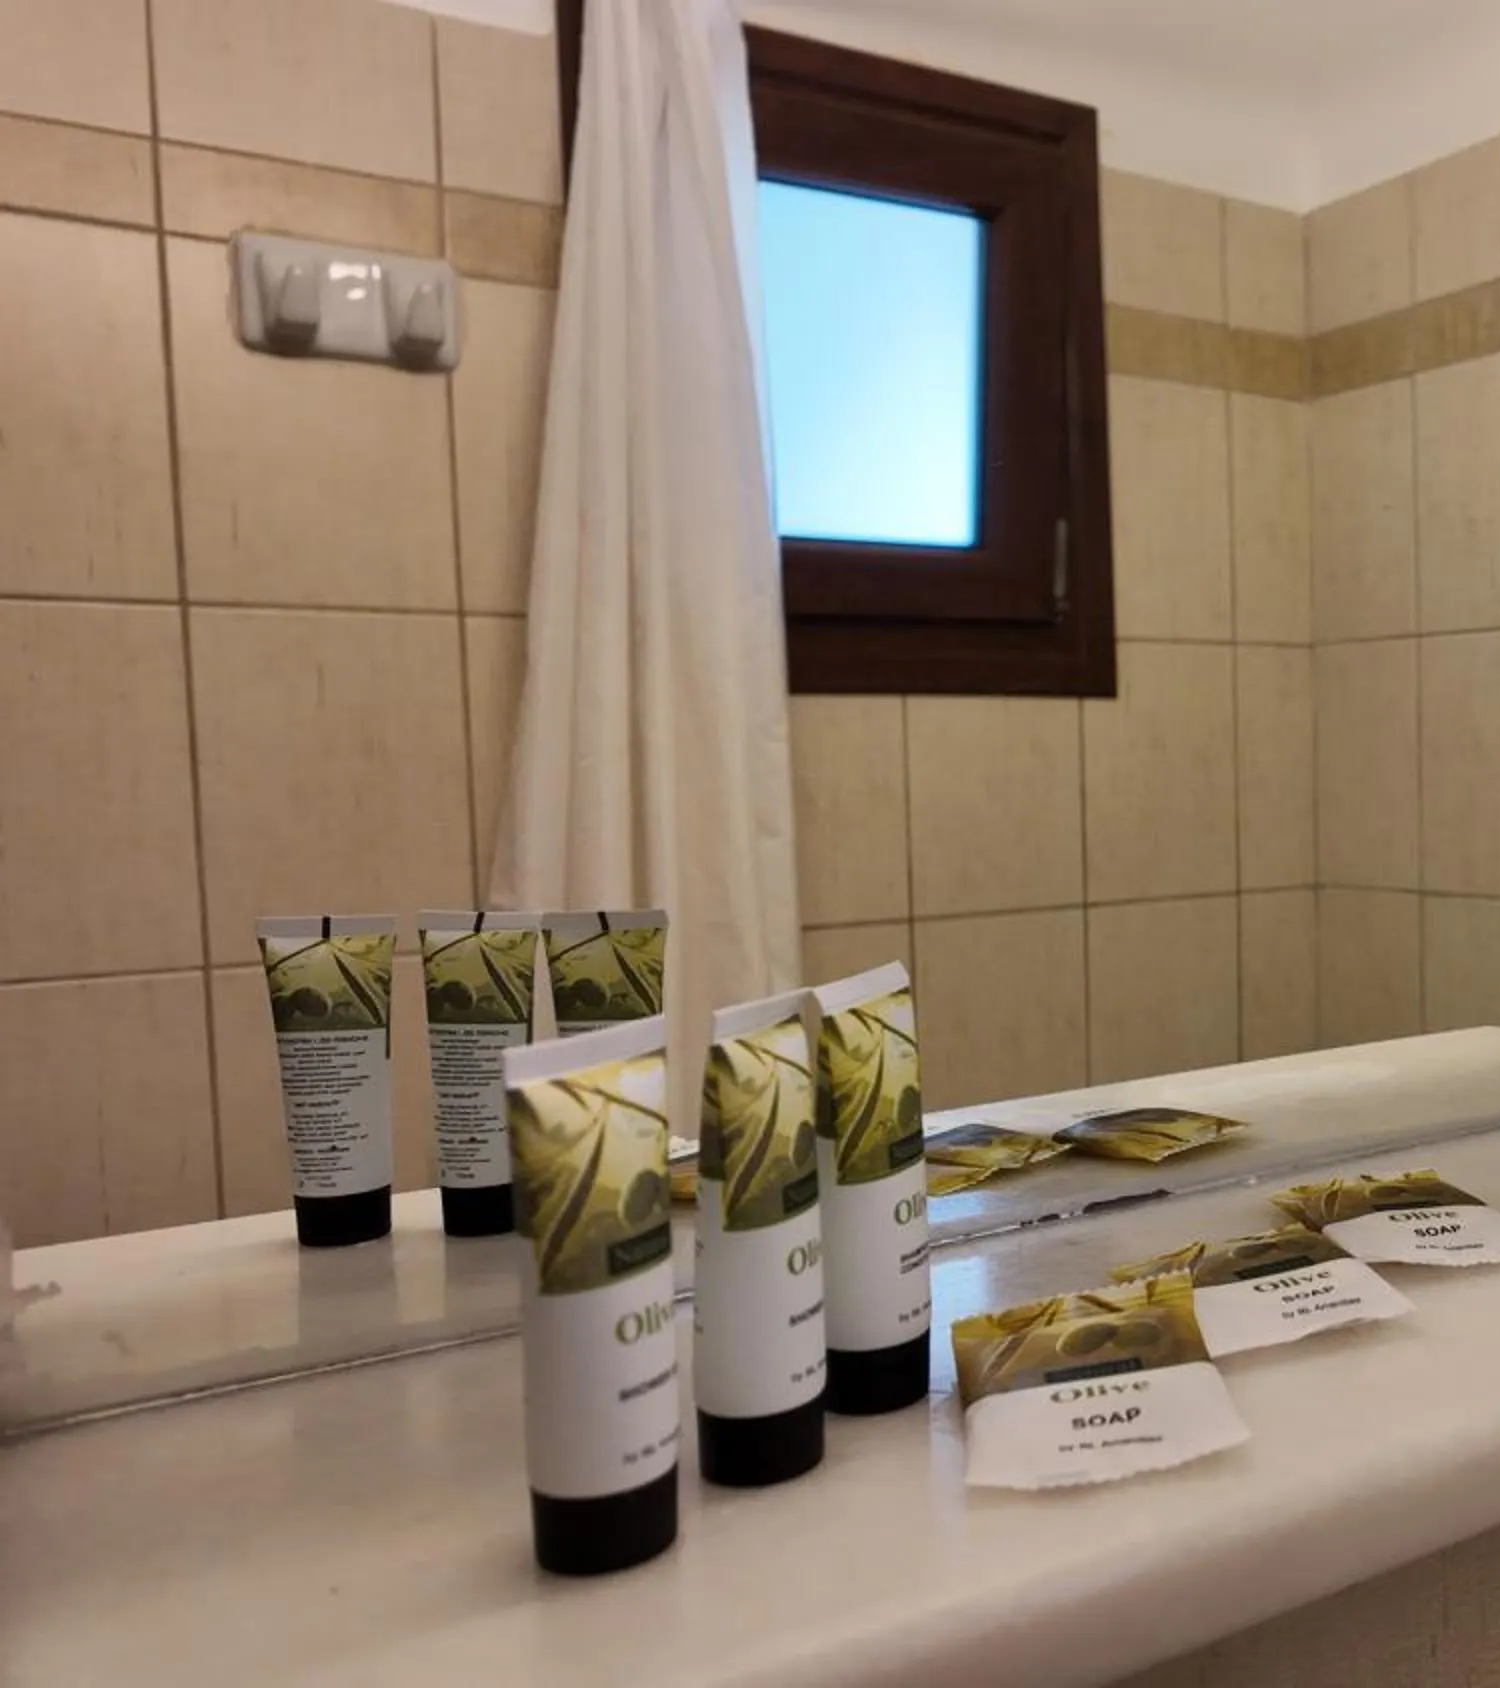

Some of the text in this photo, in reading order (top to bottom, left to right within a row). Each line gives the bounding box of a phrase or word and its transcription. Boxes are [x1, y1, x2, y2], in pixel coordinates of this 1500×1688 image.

[1388, 1211, 1457, 1222] Olive
[1414, 1224, 1461, 1237] SOAP
[1253, 1271, 1331, 1293] Olive
[614, 1301, 676, 1345] Oliv
[1050, 1380, 1149, 1403] Olive
[1071, 1406, 1141, 1430] SOAP
